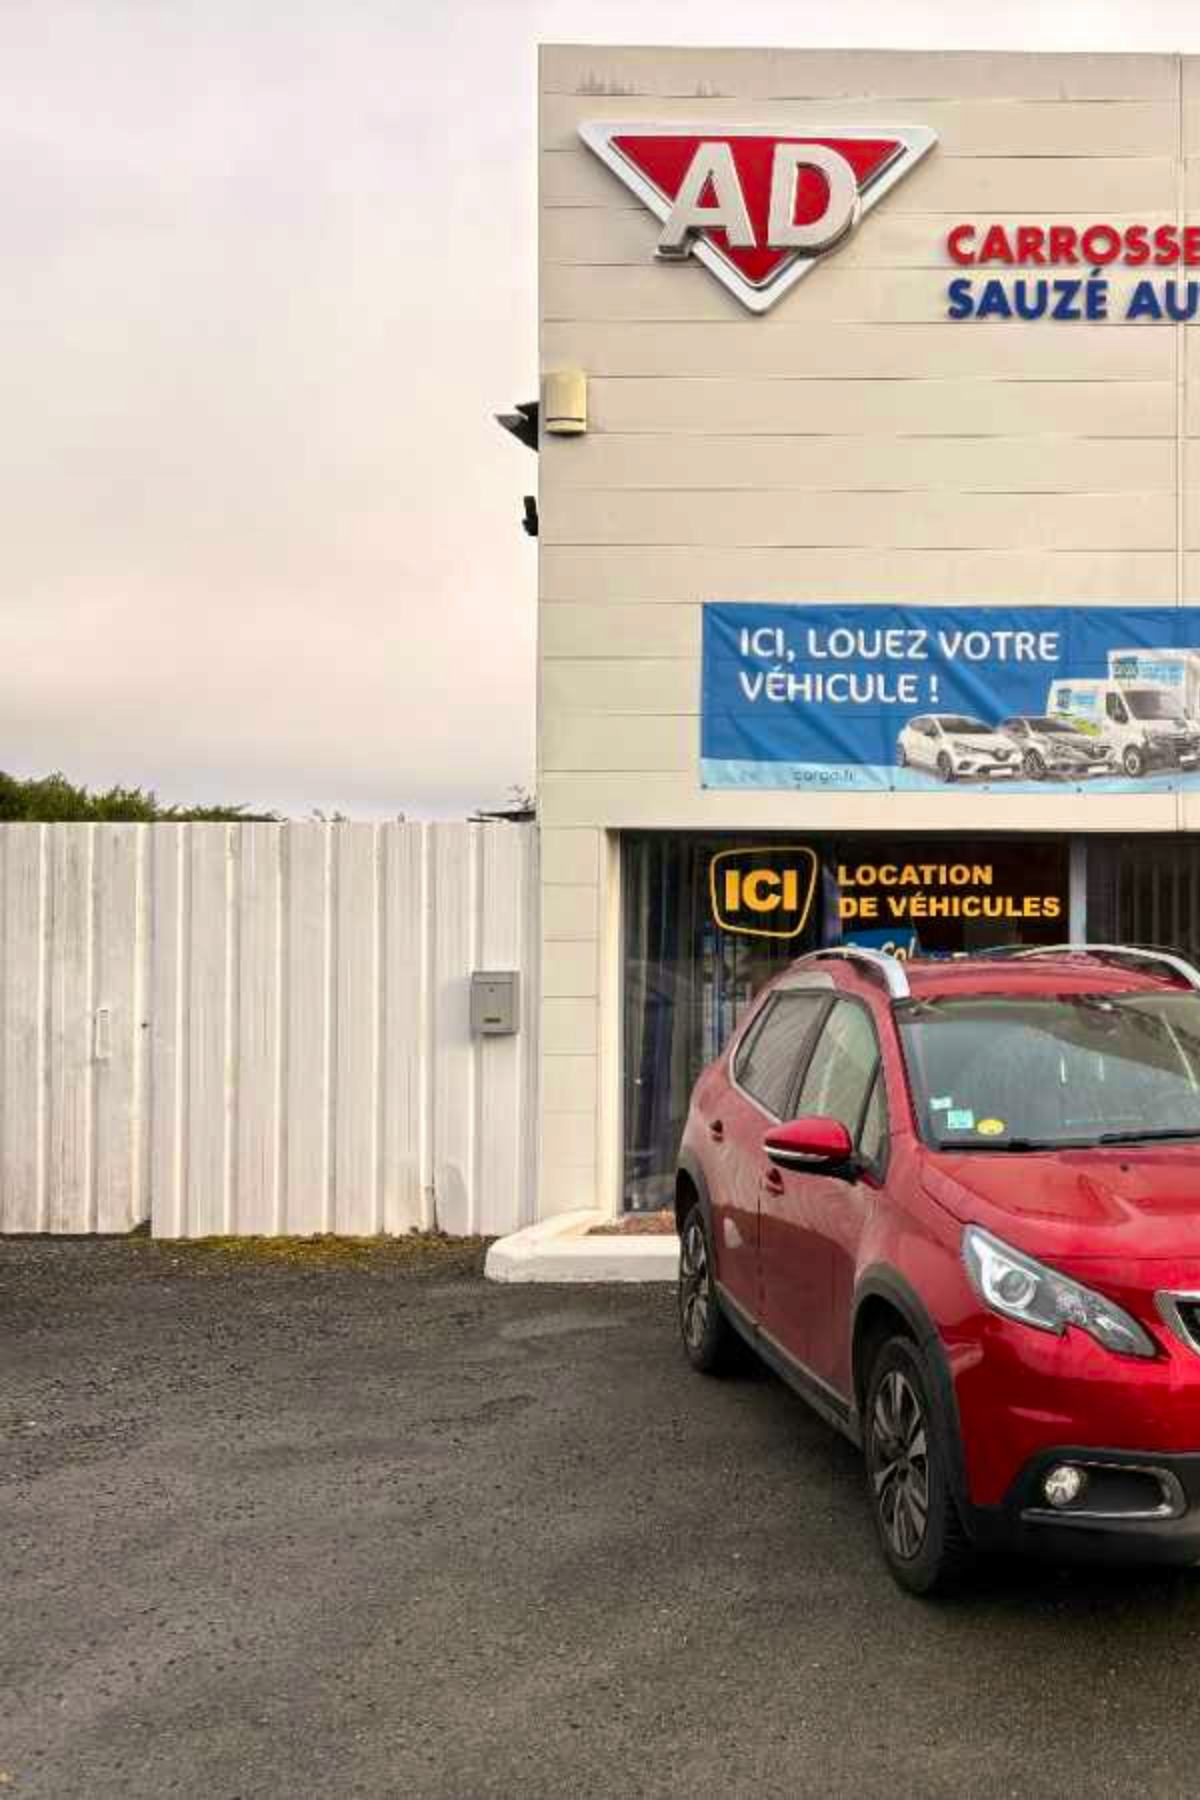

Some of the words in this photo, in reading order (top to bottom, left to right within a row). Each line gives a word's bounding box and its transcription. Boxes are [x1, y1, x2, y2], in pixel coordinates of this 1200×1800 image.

[654, 141, 859, 257] AD
[947, 268, 1108, 321] SAUZÉ
[739, 626, 796, 662] ICI,
[808, 628, 929, 660] LOUEZ
[936, 630, 1061, 661] VOTRE
[739, 663, 919, 703] VÉHICULE
[927, 675, 940, 702] !
[724, 868, 798, 912] ICI
[838, 865, 993, 886] LOCATION
[839, 896, 880, 917] DE
[887, 892, 1062, 918] VÉHICULES
